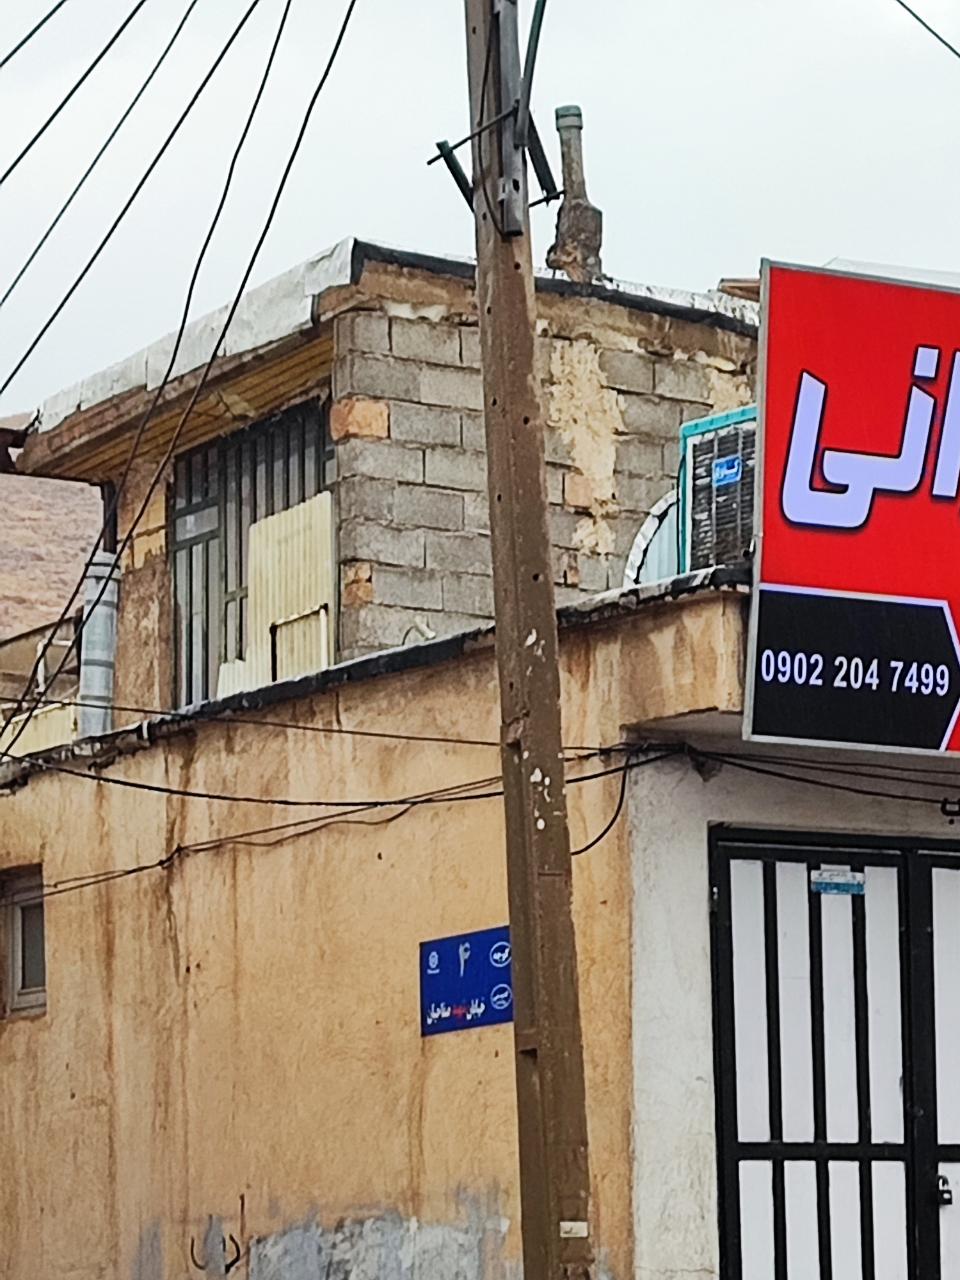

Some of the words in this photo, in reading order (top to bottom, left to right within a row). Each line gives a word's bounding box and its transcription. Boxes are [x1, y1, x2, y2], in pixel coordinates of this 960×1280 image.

[761, 649, 824, 687] 0902
[833, 656, 879, 690] 204
[890, 661, 950, 696] 7499
